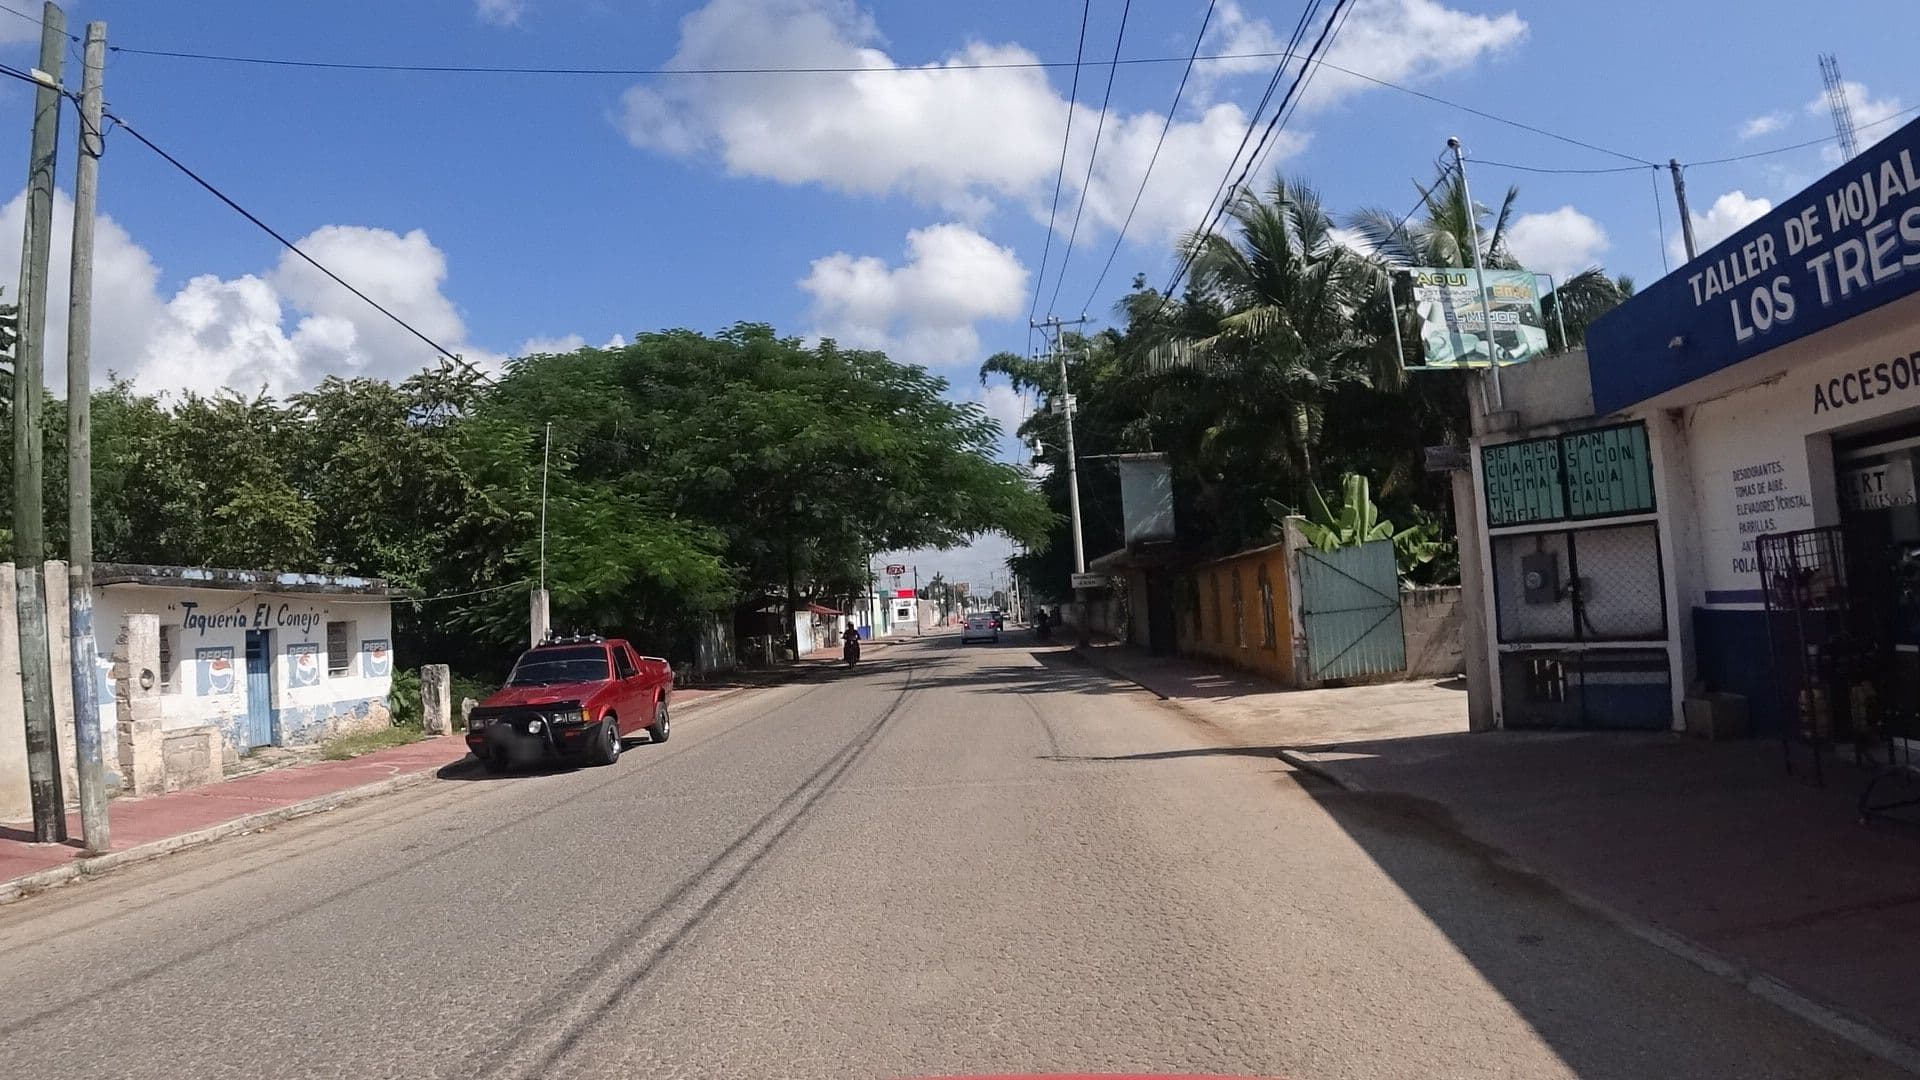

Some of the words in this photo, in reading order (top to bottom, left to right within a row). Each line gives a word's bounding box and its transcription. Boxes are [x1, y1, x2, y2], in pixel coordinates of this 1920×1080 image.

[1688, 233, 1777, 306] TALLER
[1784, 205, 1823, 256] DE
[1731, 275, 1795, 341] LOS
[1487, 448, 1505, 461] SE
[253, 603, 271, 627] El
